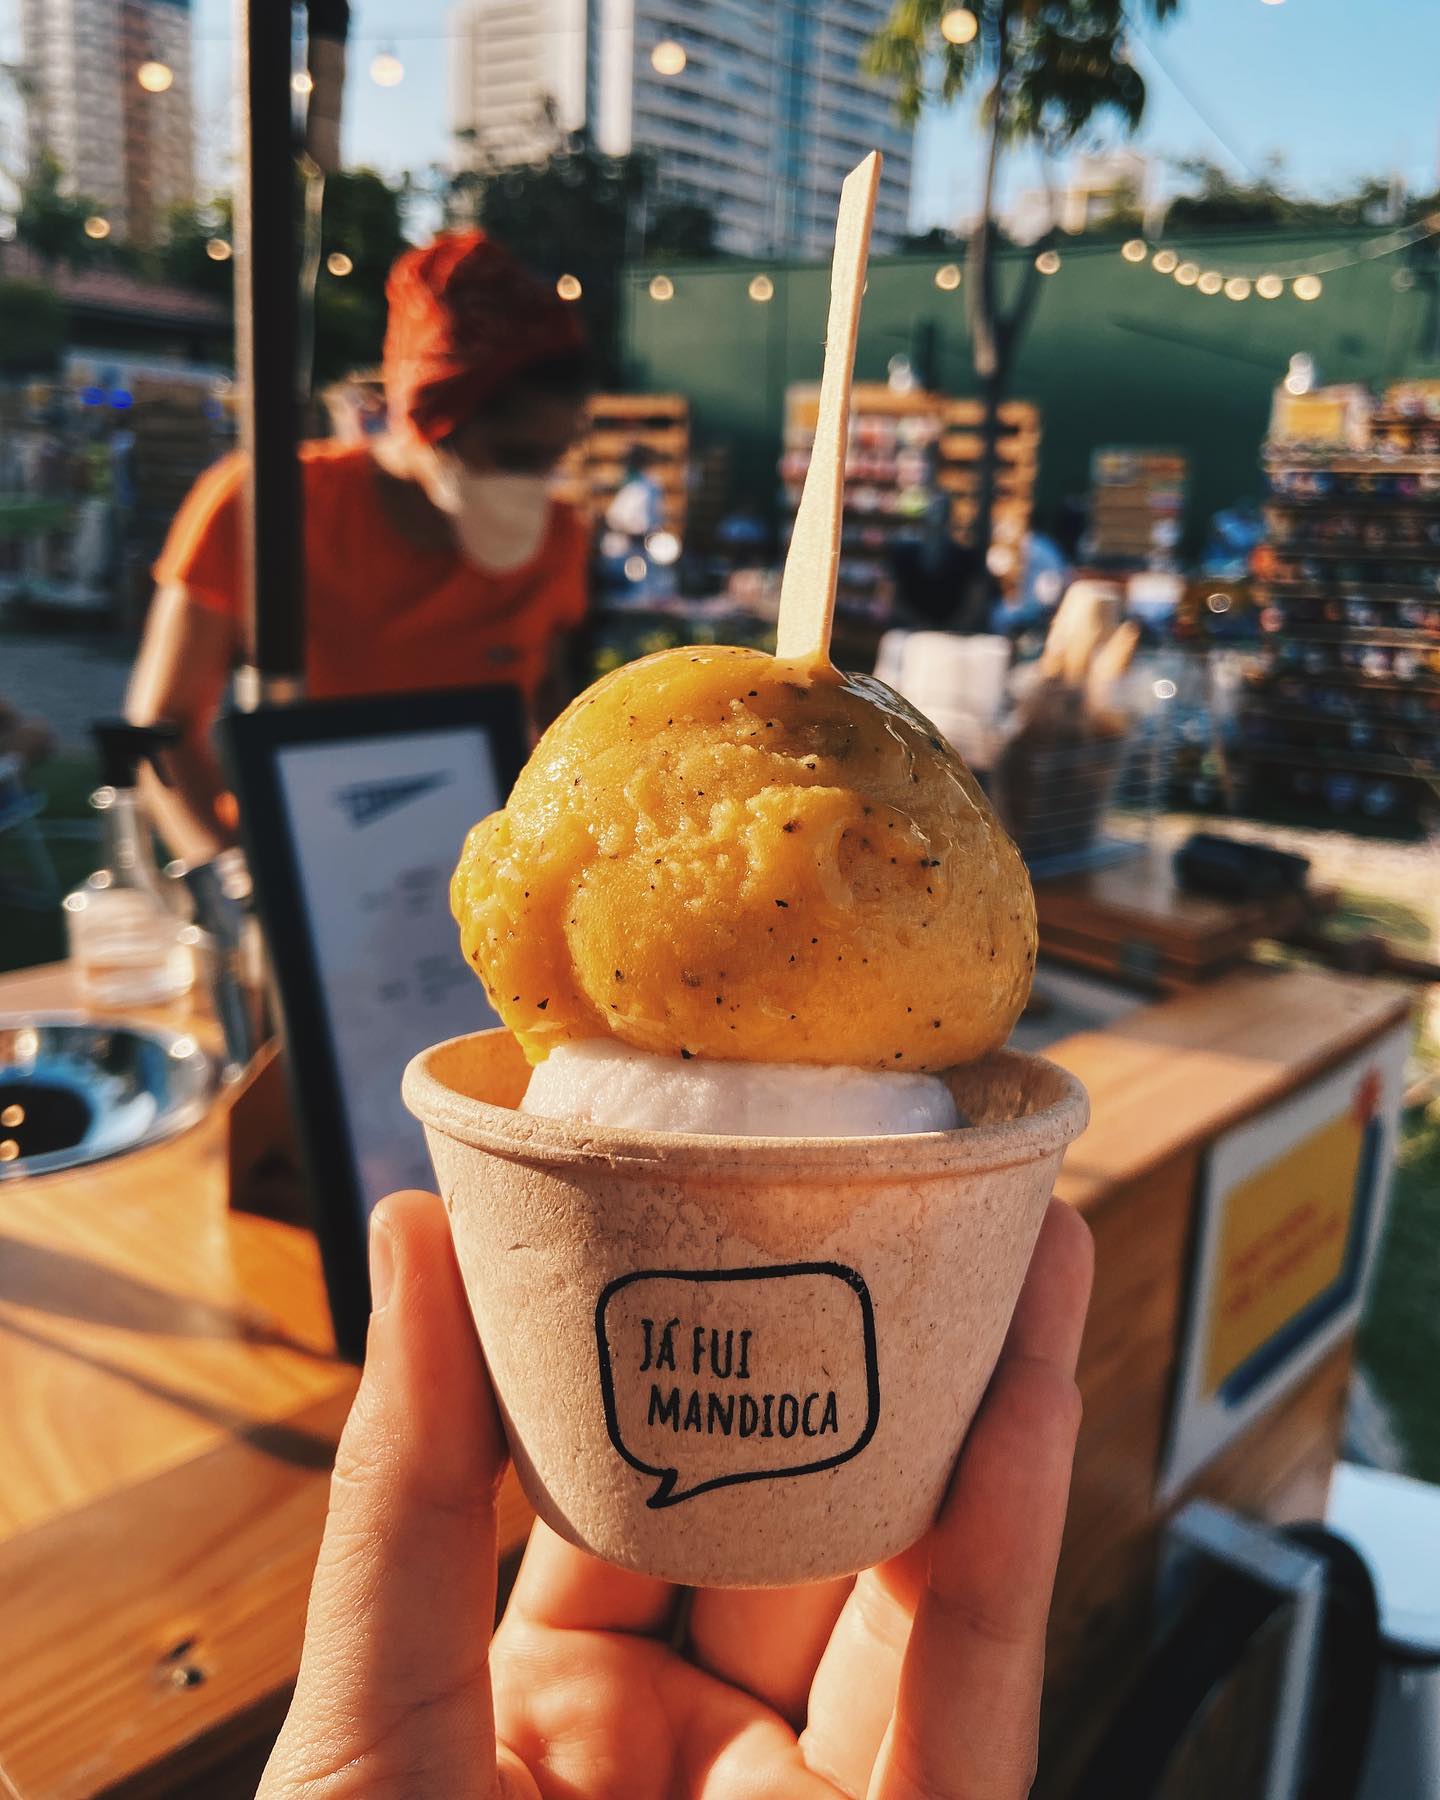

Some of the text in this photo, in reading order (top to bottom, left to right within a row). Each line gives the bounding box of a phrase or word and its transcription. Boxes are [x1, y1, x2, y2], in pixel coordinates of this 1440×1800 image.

[639, 1317, 753, 1379] JÁ FUI
[647, 1383, 839, 1439] MANDIOCA
